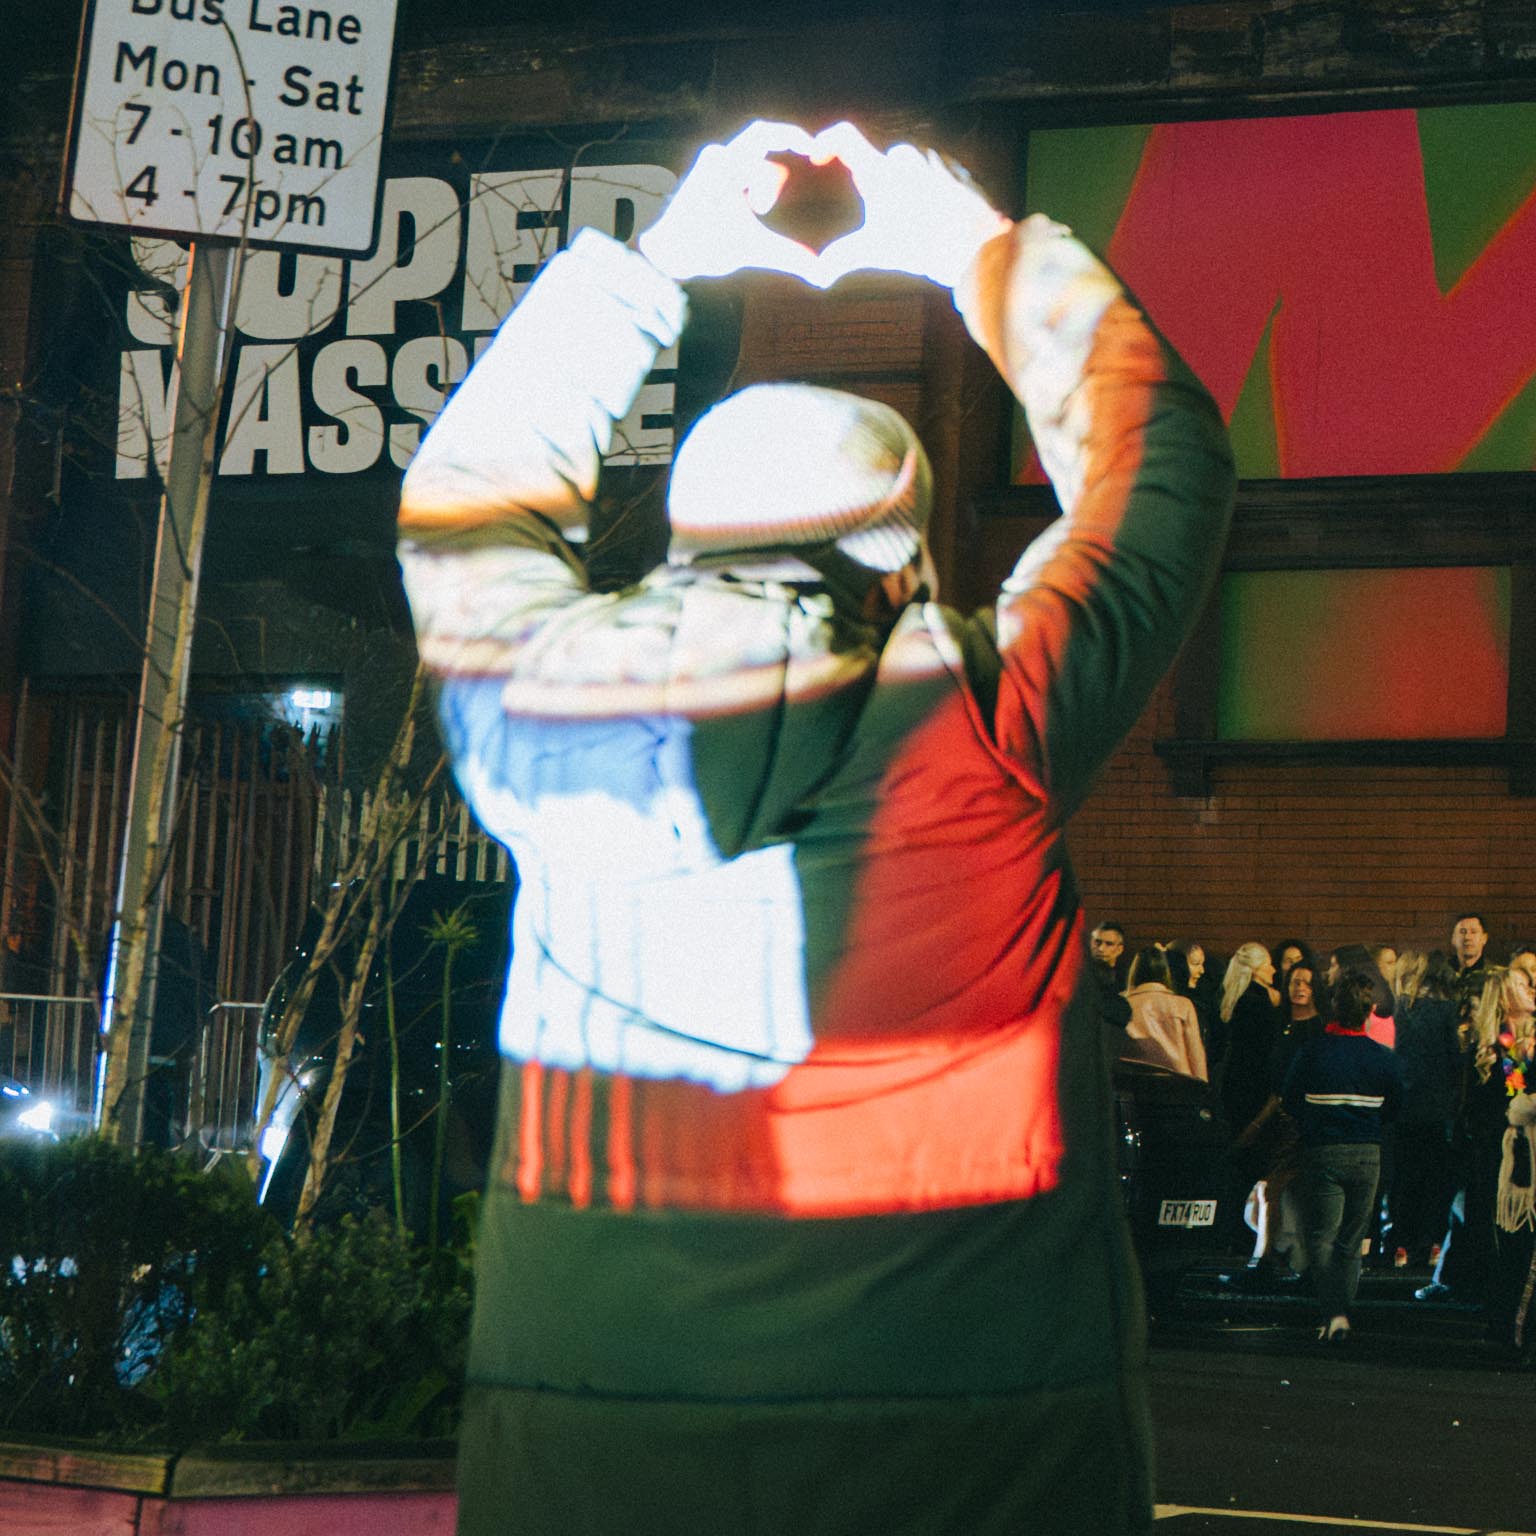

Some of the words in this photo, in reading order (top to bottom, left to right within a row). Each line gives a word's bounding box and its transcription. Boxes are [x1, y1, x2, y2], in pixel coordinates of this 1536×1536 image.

[113, 41, 221, 96] Mon
[279, 65, 364, 116] Sat
[124, 104, 152, 146] 7
[206, 116, 345, 170] 10am
[125, 165, 158, 206] 4
[219, 175, 327, 229] 7pm
